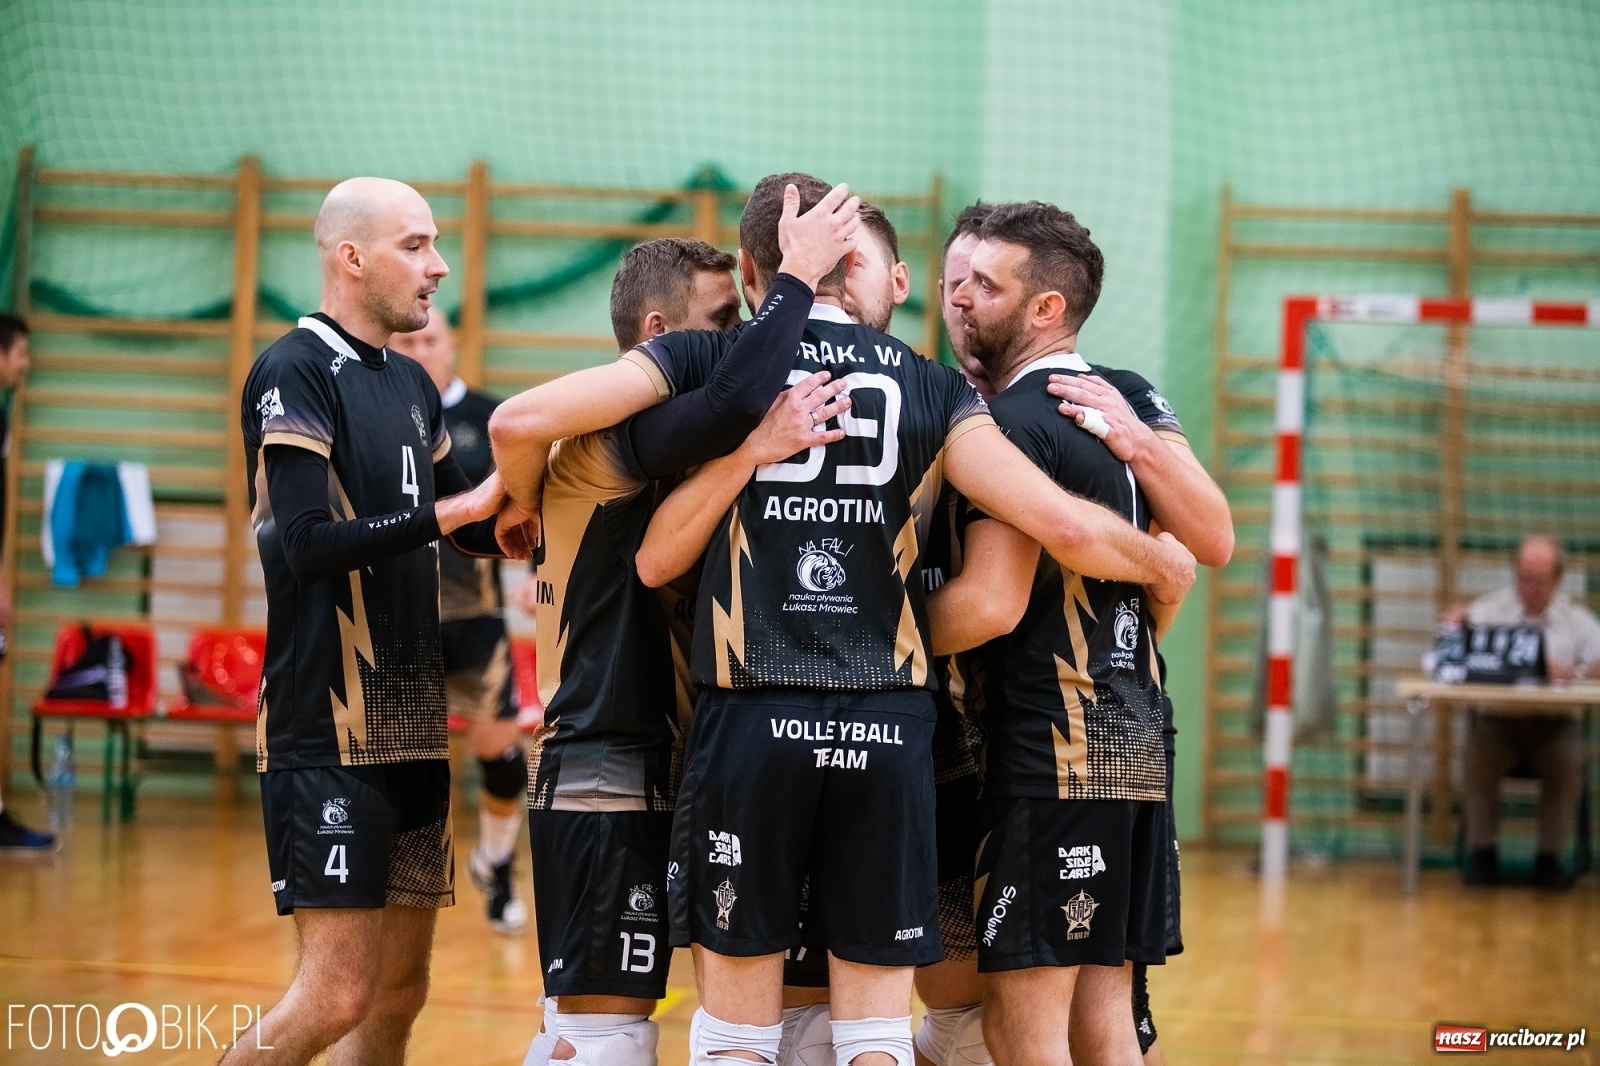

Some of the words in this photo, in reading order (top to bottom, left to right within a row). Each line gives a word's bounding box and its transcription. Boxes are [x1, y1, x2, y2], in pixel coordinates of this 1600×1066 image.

[751, 294, 784, 327] KIPSTA
[796, 341, 865, 366] RAK.
[873, 345, 902, 367] W
[402, 445, 420, 507] 4
[763, 495, 885, 524] AGROTIM
[368, 512, 411, 529] KIPSTA
[798, 540, 816, 555] NA
[821, 537, 855, 558] FALI
[789, 593, 816, 601] nauka
[782, 603, 817, 612] Łukasz
[819, 604, 859, 614] Mrowiec
[770, 718, 904, 745] VOLLEYBALL
[813, 747, 868, 770] TEAM
[708, 830, 732, 844] DARK
[708, 852, 732, 866] CARS
[1058, 845, 1092, 858] DARK
[324, 844, 349, 884] 4
[1065, 857, 1092, 869] SIDE
[1060, 868, 1091, 880] CARS
[620, 931, 656, 974] 13
